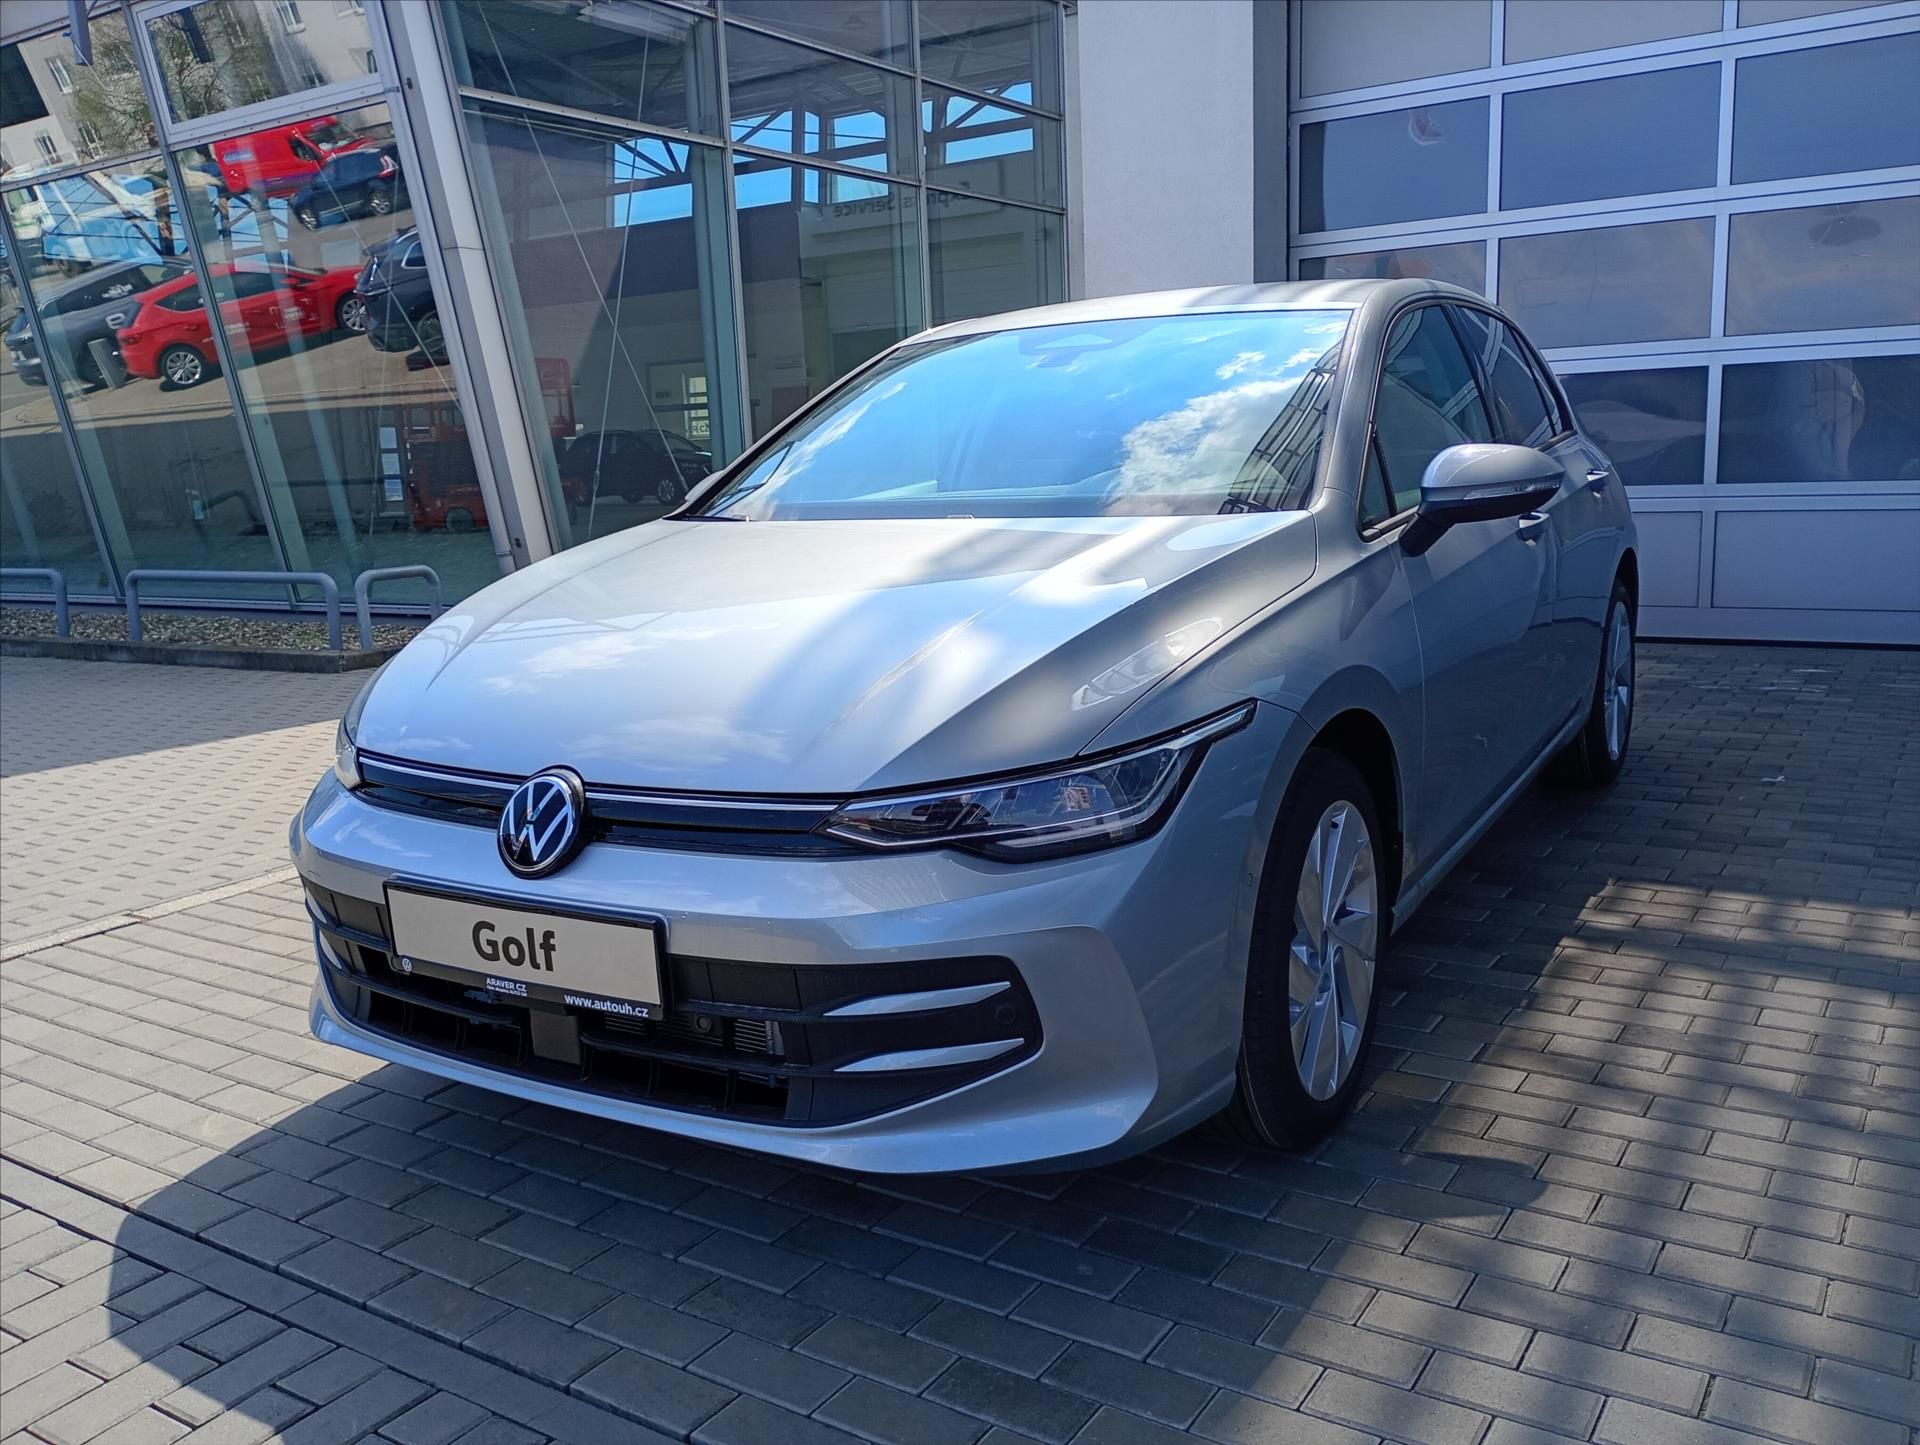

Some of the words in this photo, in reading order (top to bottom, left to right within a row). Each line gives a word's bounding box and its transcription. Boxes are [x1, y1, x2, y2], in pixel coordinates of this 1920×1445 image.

[472, 920, 557, 972] Golf
[486, 977, 515, 990] ARAVER
[564, 994, 649, 1018] www.autouh.cz
